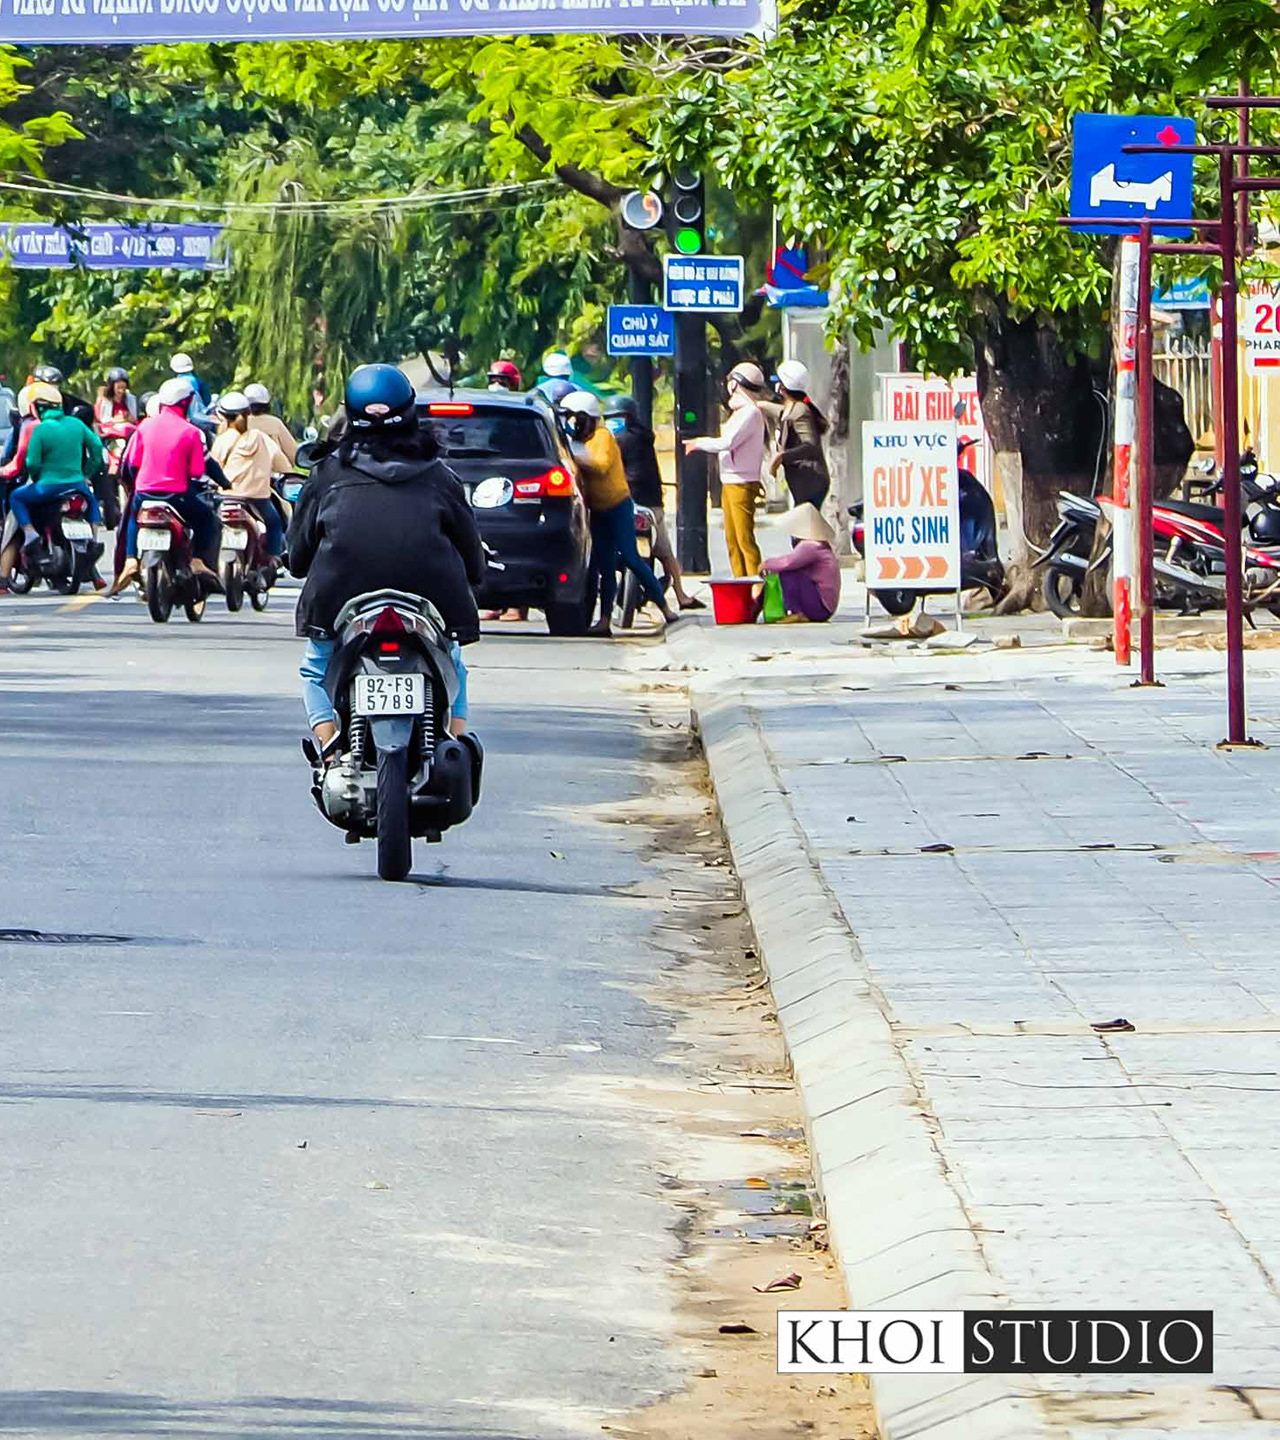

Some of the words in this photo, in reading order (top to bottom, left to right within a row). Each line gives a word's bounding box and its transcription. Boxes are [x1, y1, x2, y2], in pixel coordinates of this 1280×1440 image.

[873, 435, 907, 448] KHU
[914, 433, 948, 451] VỰC
[873, 457, 913, 508] GIỮ
[920, 465, 948, 507] XE
[874, 516, 905, 551] HỌC
[912, 515, 949, 545] SINH
[367, 677, 414, 693] 92-F9
[367, 694, 414, 710] 5789
